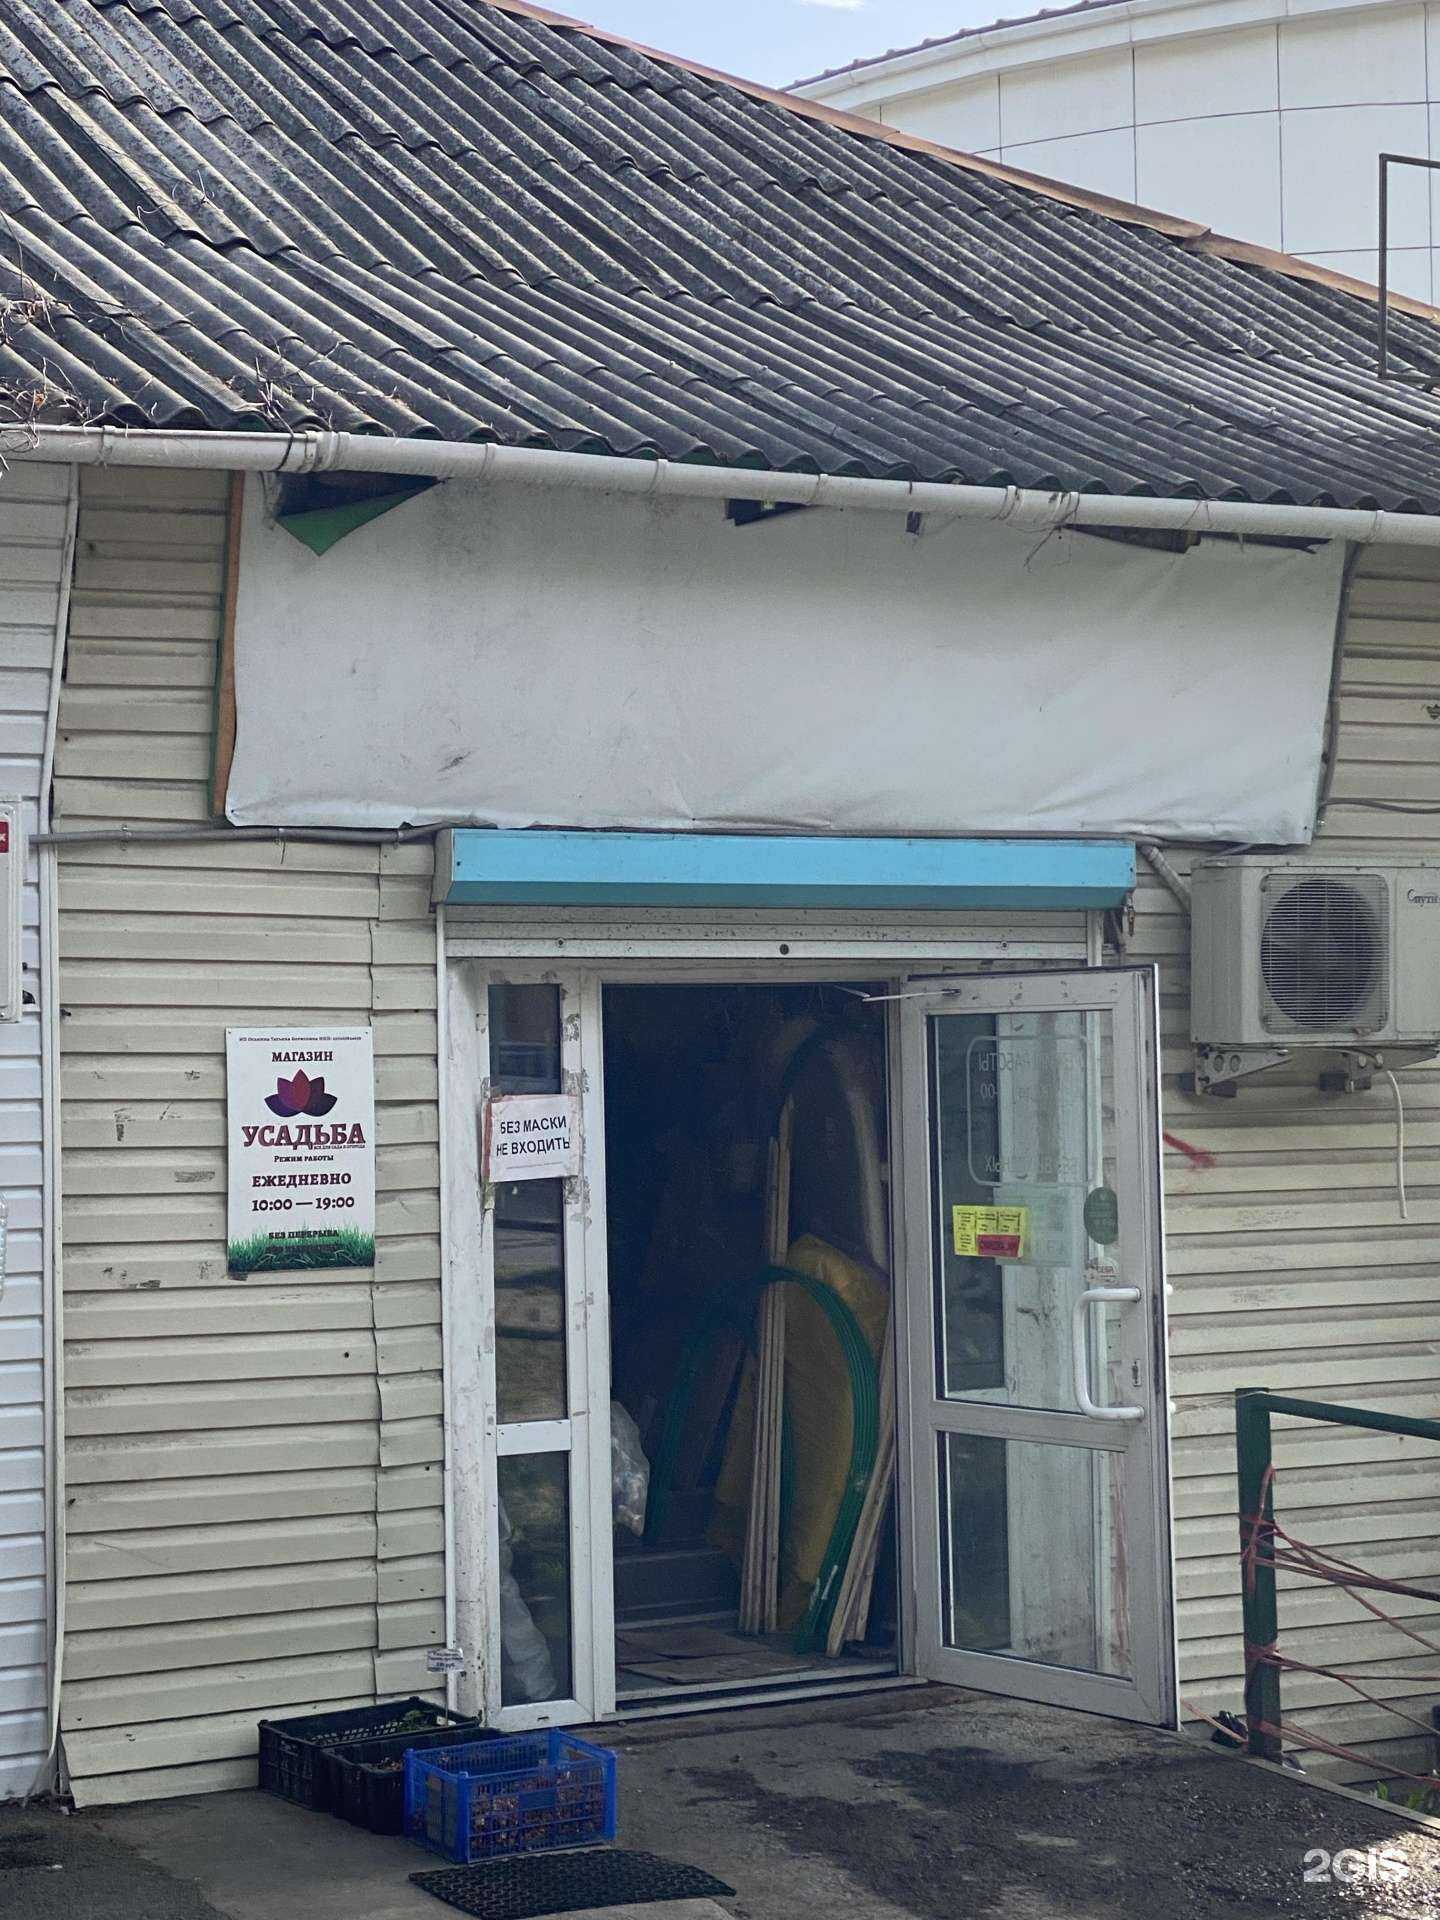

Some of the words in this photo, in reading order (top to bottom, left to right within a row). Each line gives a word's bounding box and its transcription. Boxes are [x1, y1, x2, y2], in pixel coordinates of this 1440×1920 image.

[271, 1050, 333, 1062] МАГАЗИН
[500, 1121, 521, 1134] БЕЗ
[523, 1116, 567, 1133] МАСКИ
[242, 1123, 366, 1151] УСАДЬБА
[496, 1143, 509, 1157] НЕ
[511, 1137, 571, 1155] ВХОДИТЬ
[252, 1173, 352, 1188] ЕЖЕДНЕВНО
[252, 1199, 293, 1211] 10:00
[315, 1197, 355, 1210] 19:00
